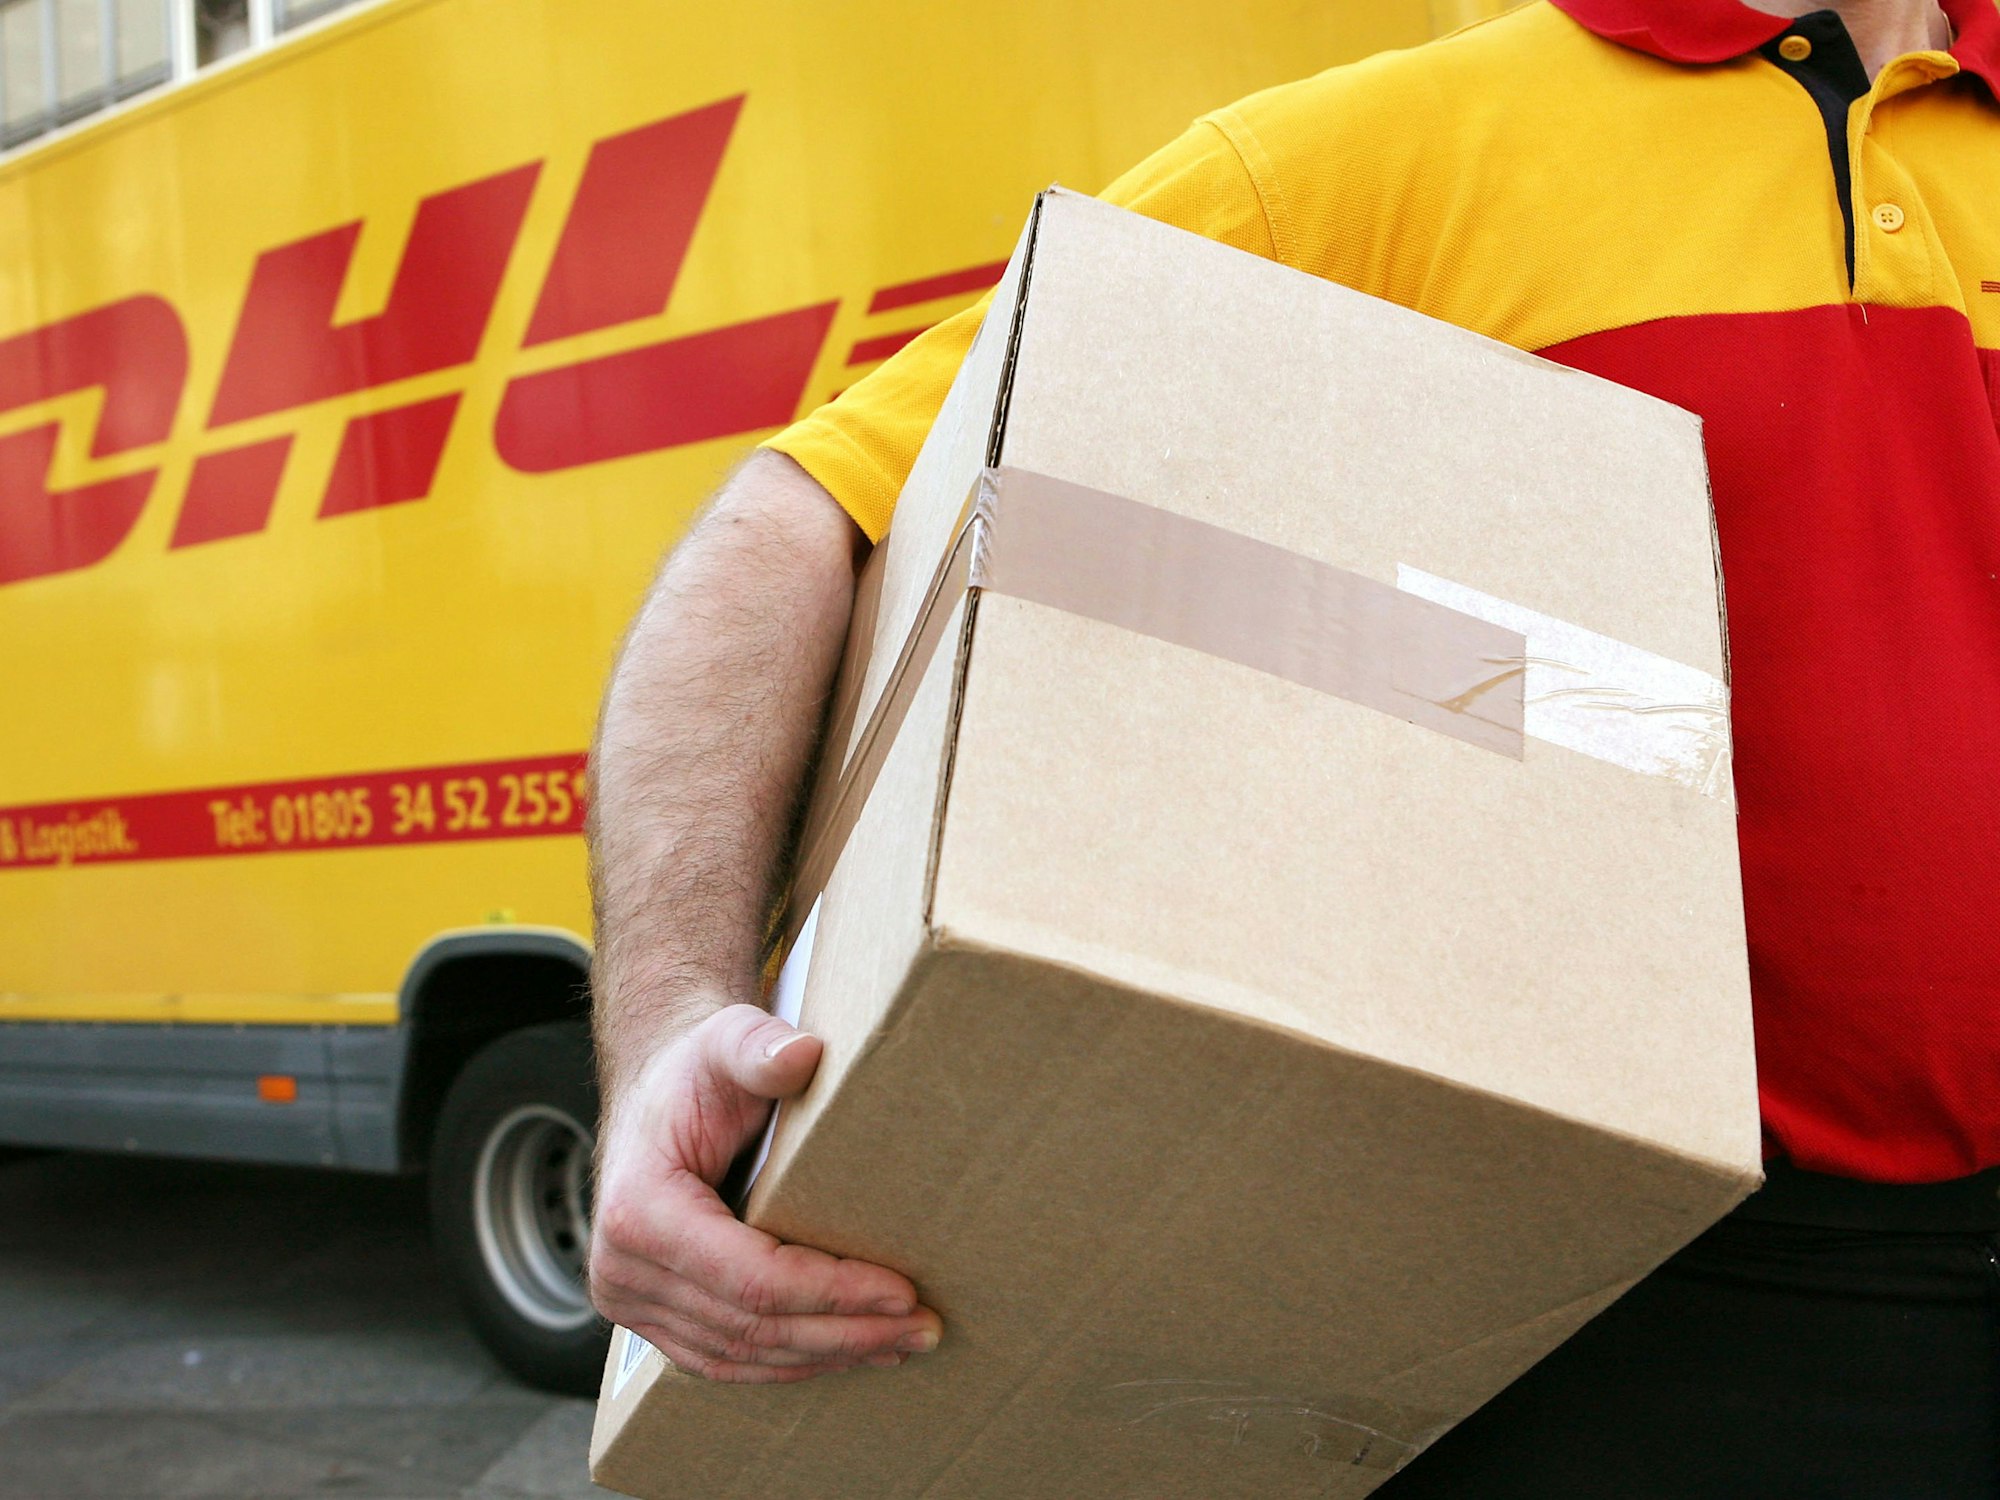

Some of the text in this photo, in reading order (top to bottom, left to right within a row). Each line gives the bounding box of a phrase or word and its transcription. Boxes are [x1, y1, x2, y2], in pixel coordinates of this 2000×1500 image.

[0, 92, 841, 586] DHL
[270, 789, 374, 843] 01805
[390, 782, 436, 836] 34
[443, 776, 491, 832] 52
